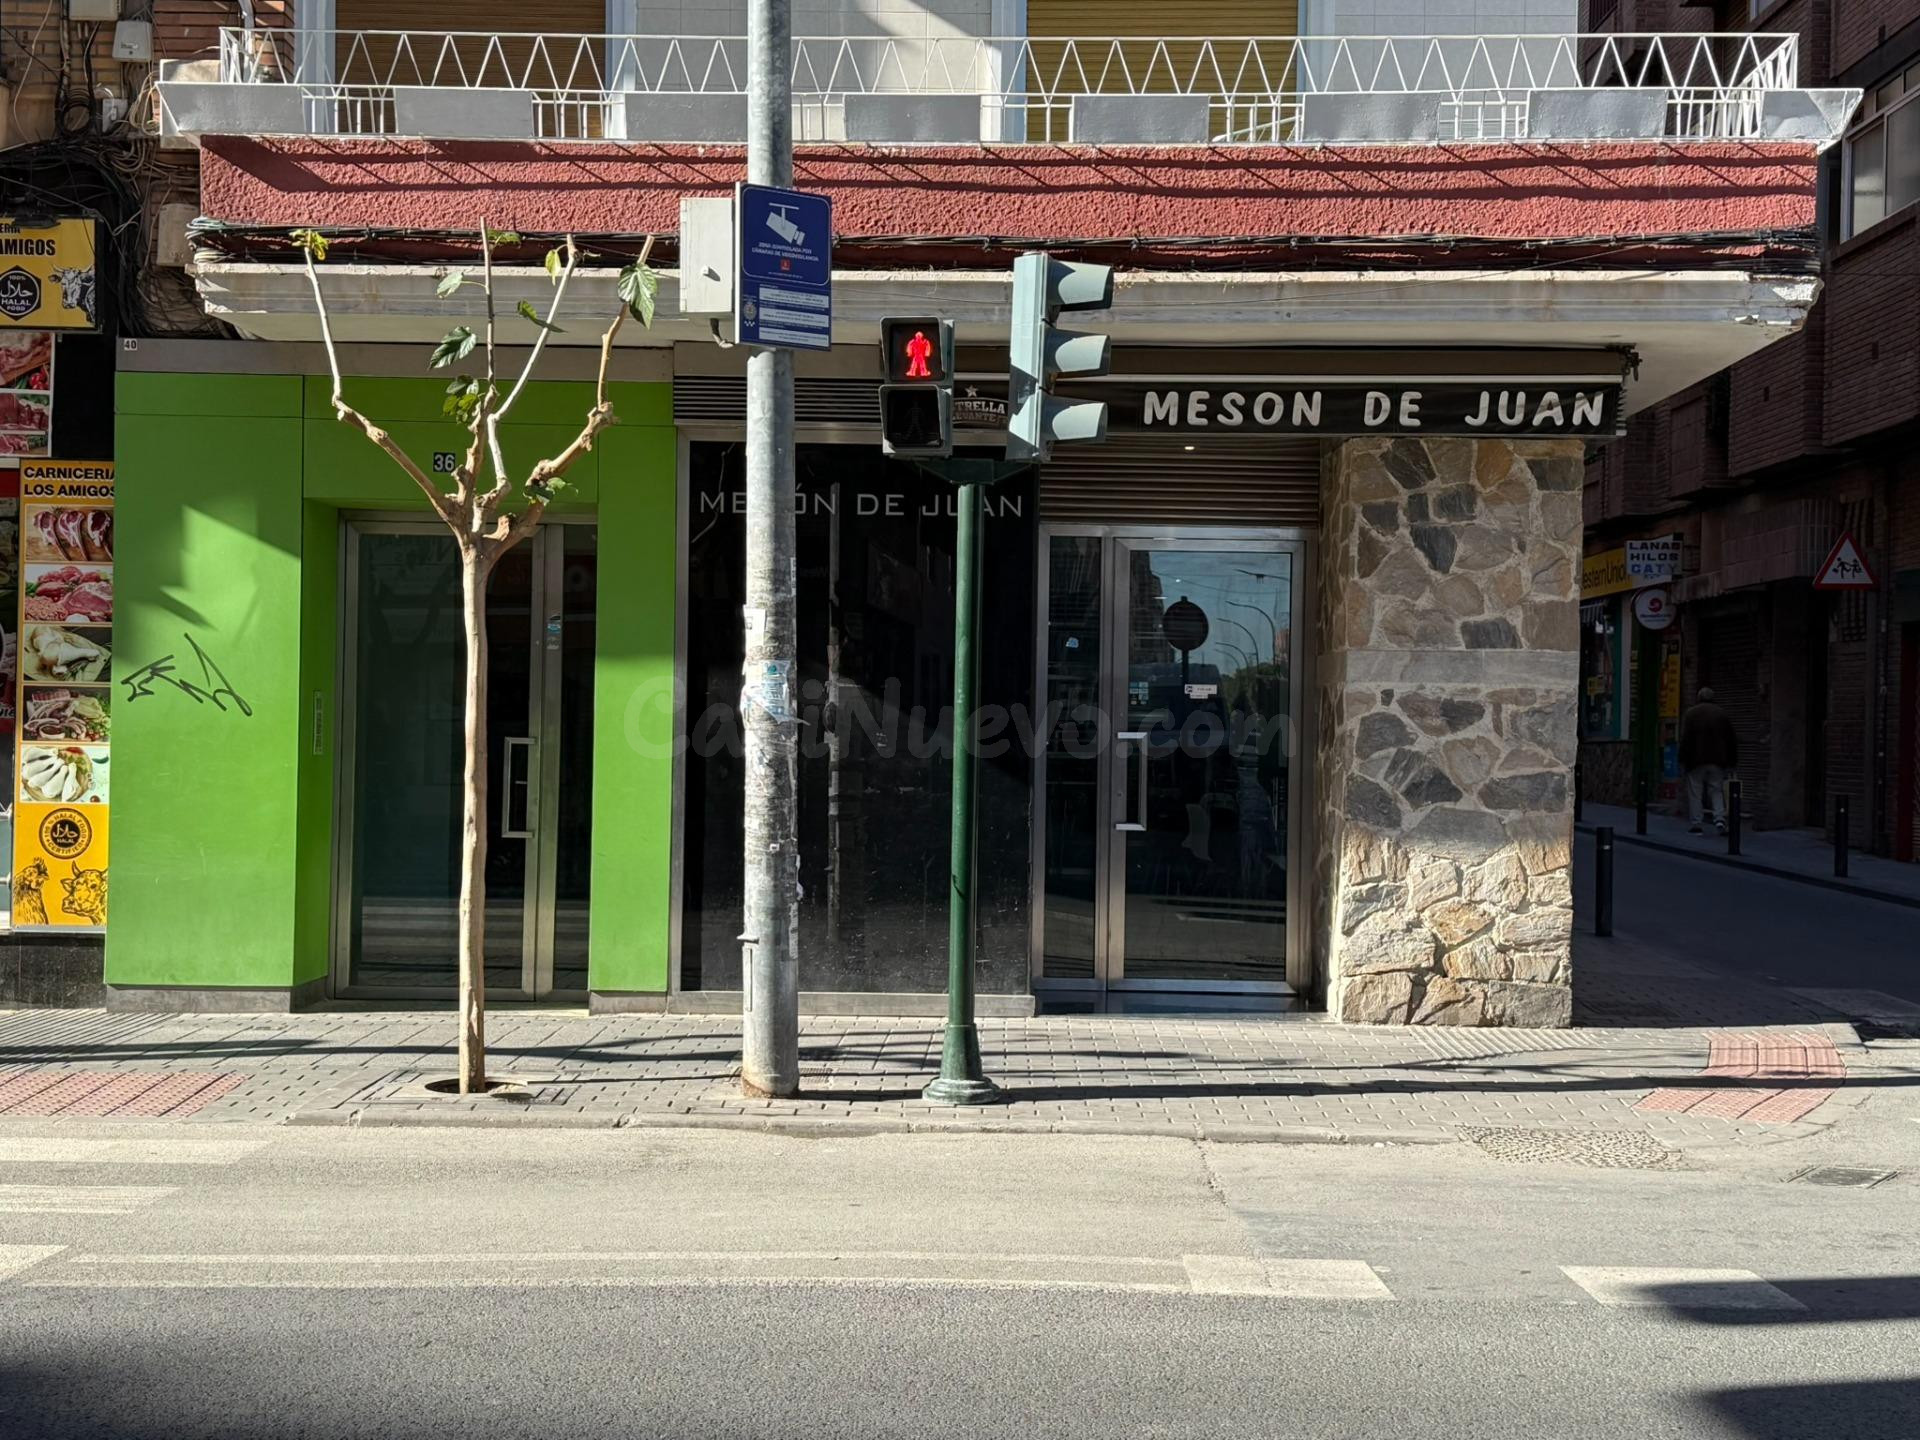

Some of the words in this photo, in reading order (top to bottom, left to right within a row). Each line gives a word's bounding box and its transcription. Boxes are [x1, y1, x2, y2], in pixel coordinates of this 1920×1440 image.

[1, 298, 31, 306] HALAL
[124, 339, 137, 349] 40
[954, 401, 1006, 414] TRELLA
[1143, 390, 1322, 426] MESON
[1363, 390, 1423, 426] DE
[1464, 390, 1604, 427] JUAN
[434, 454, 455, 471] 36
[24, 483, 54, 496] LOS
[700, 483, 836, 515] MEÓN
[857, 493, 905, 515] DE
[1629, 542, 1680, 550] LANAS
[1630, 553, 1678, 561] HILOS
[1631, 564, 1678, 573] CATY
[52, 823, 79, 838] حلال
